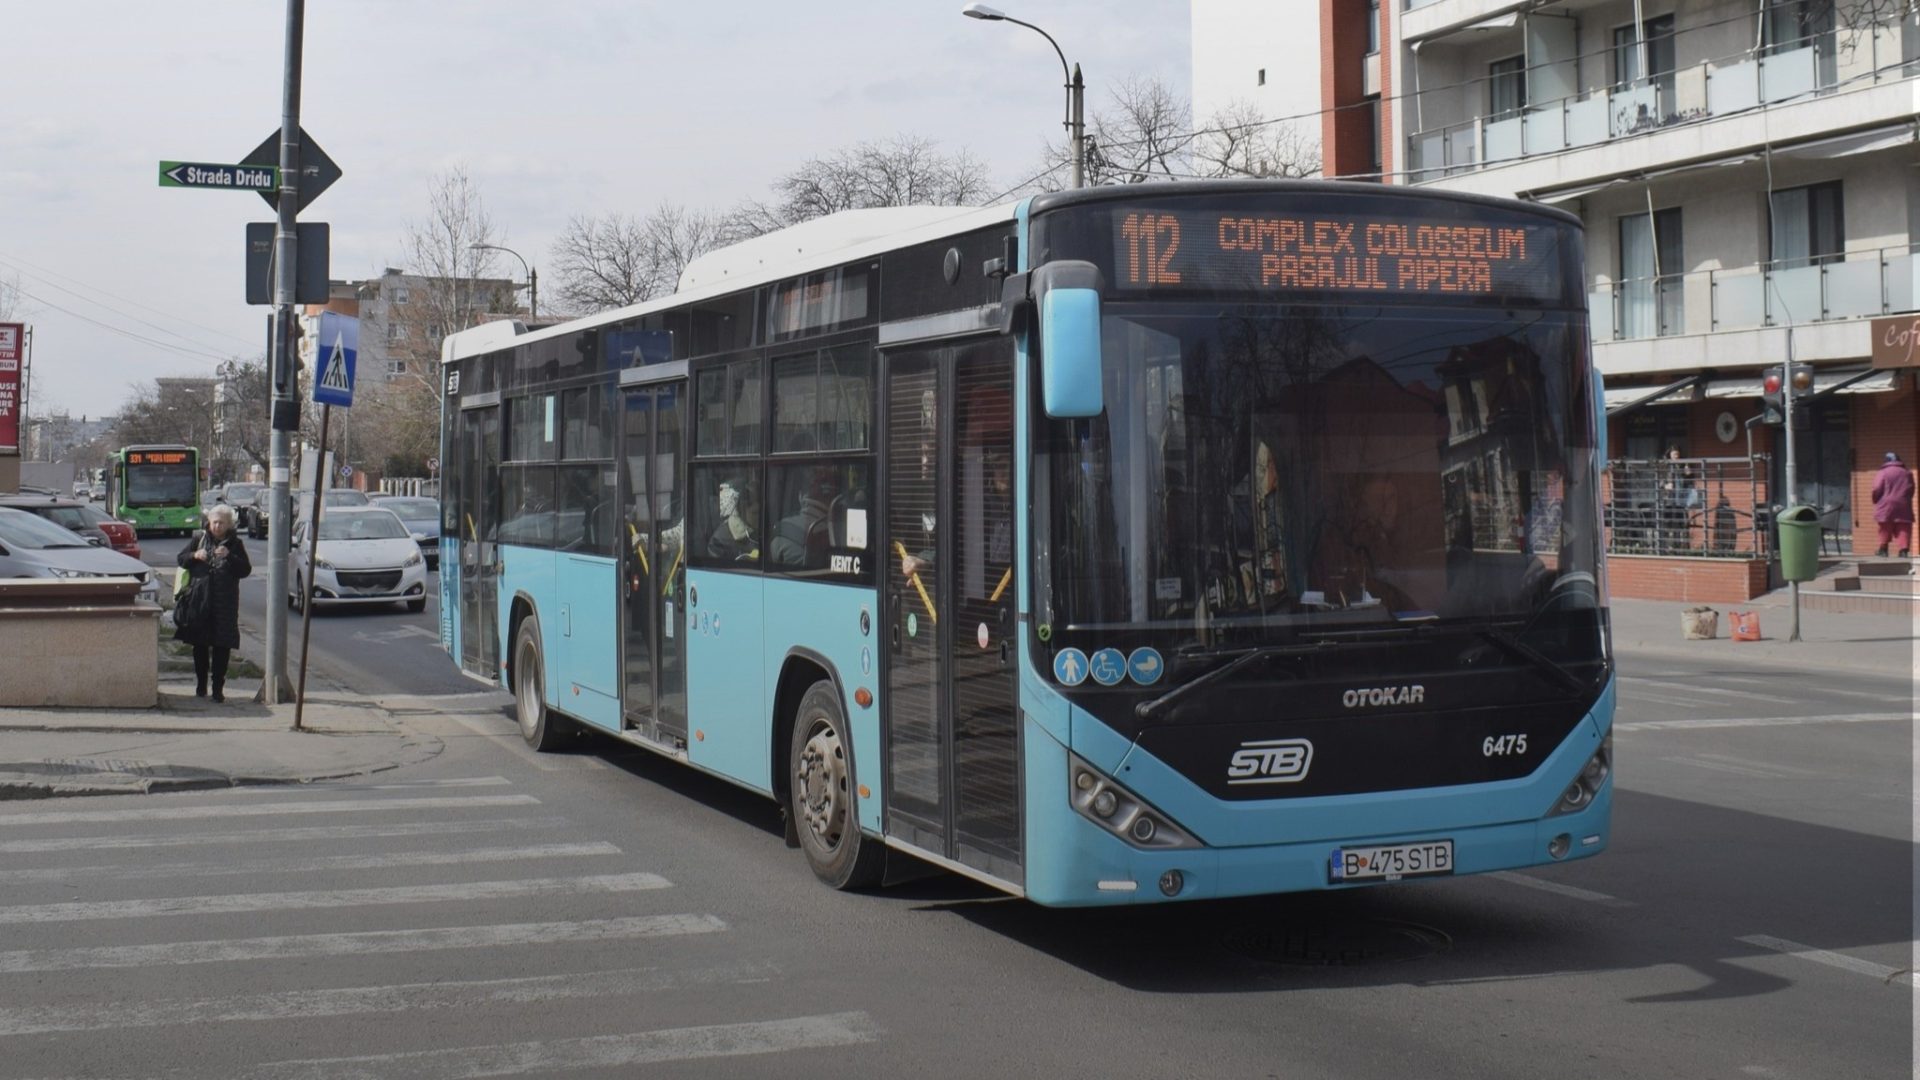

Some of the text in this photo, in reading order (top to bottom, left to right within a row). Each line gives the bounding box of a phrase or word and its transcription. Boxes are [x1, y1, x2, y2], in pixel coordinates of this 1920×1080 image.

[187, 166, 271, 187] Strada Dridu
[1122, 214, 1525, 283] 112 COMPLEX COLOSSEUM
[1262, 254, 1491, 291] PASAJUL PIPERA
[831, 555, 861, 575] KENT C
[1342, 685, 1424, 707] OTOKAR
[1483, 733, 1528, 757] 6475
[1228, 746, 1305, 777] STB
[1369, 850, 1405, 873] 475
[1408, 846, 1448, 870] STB
